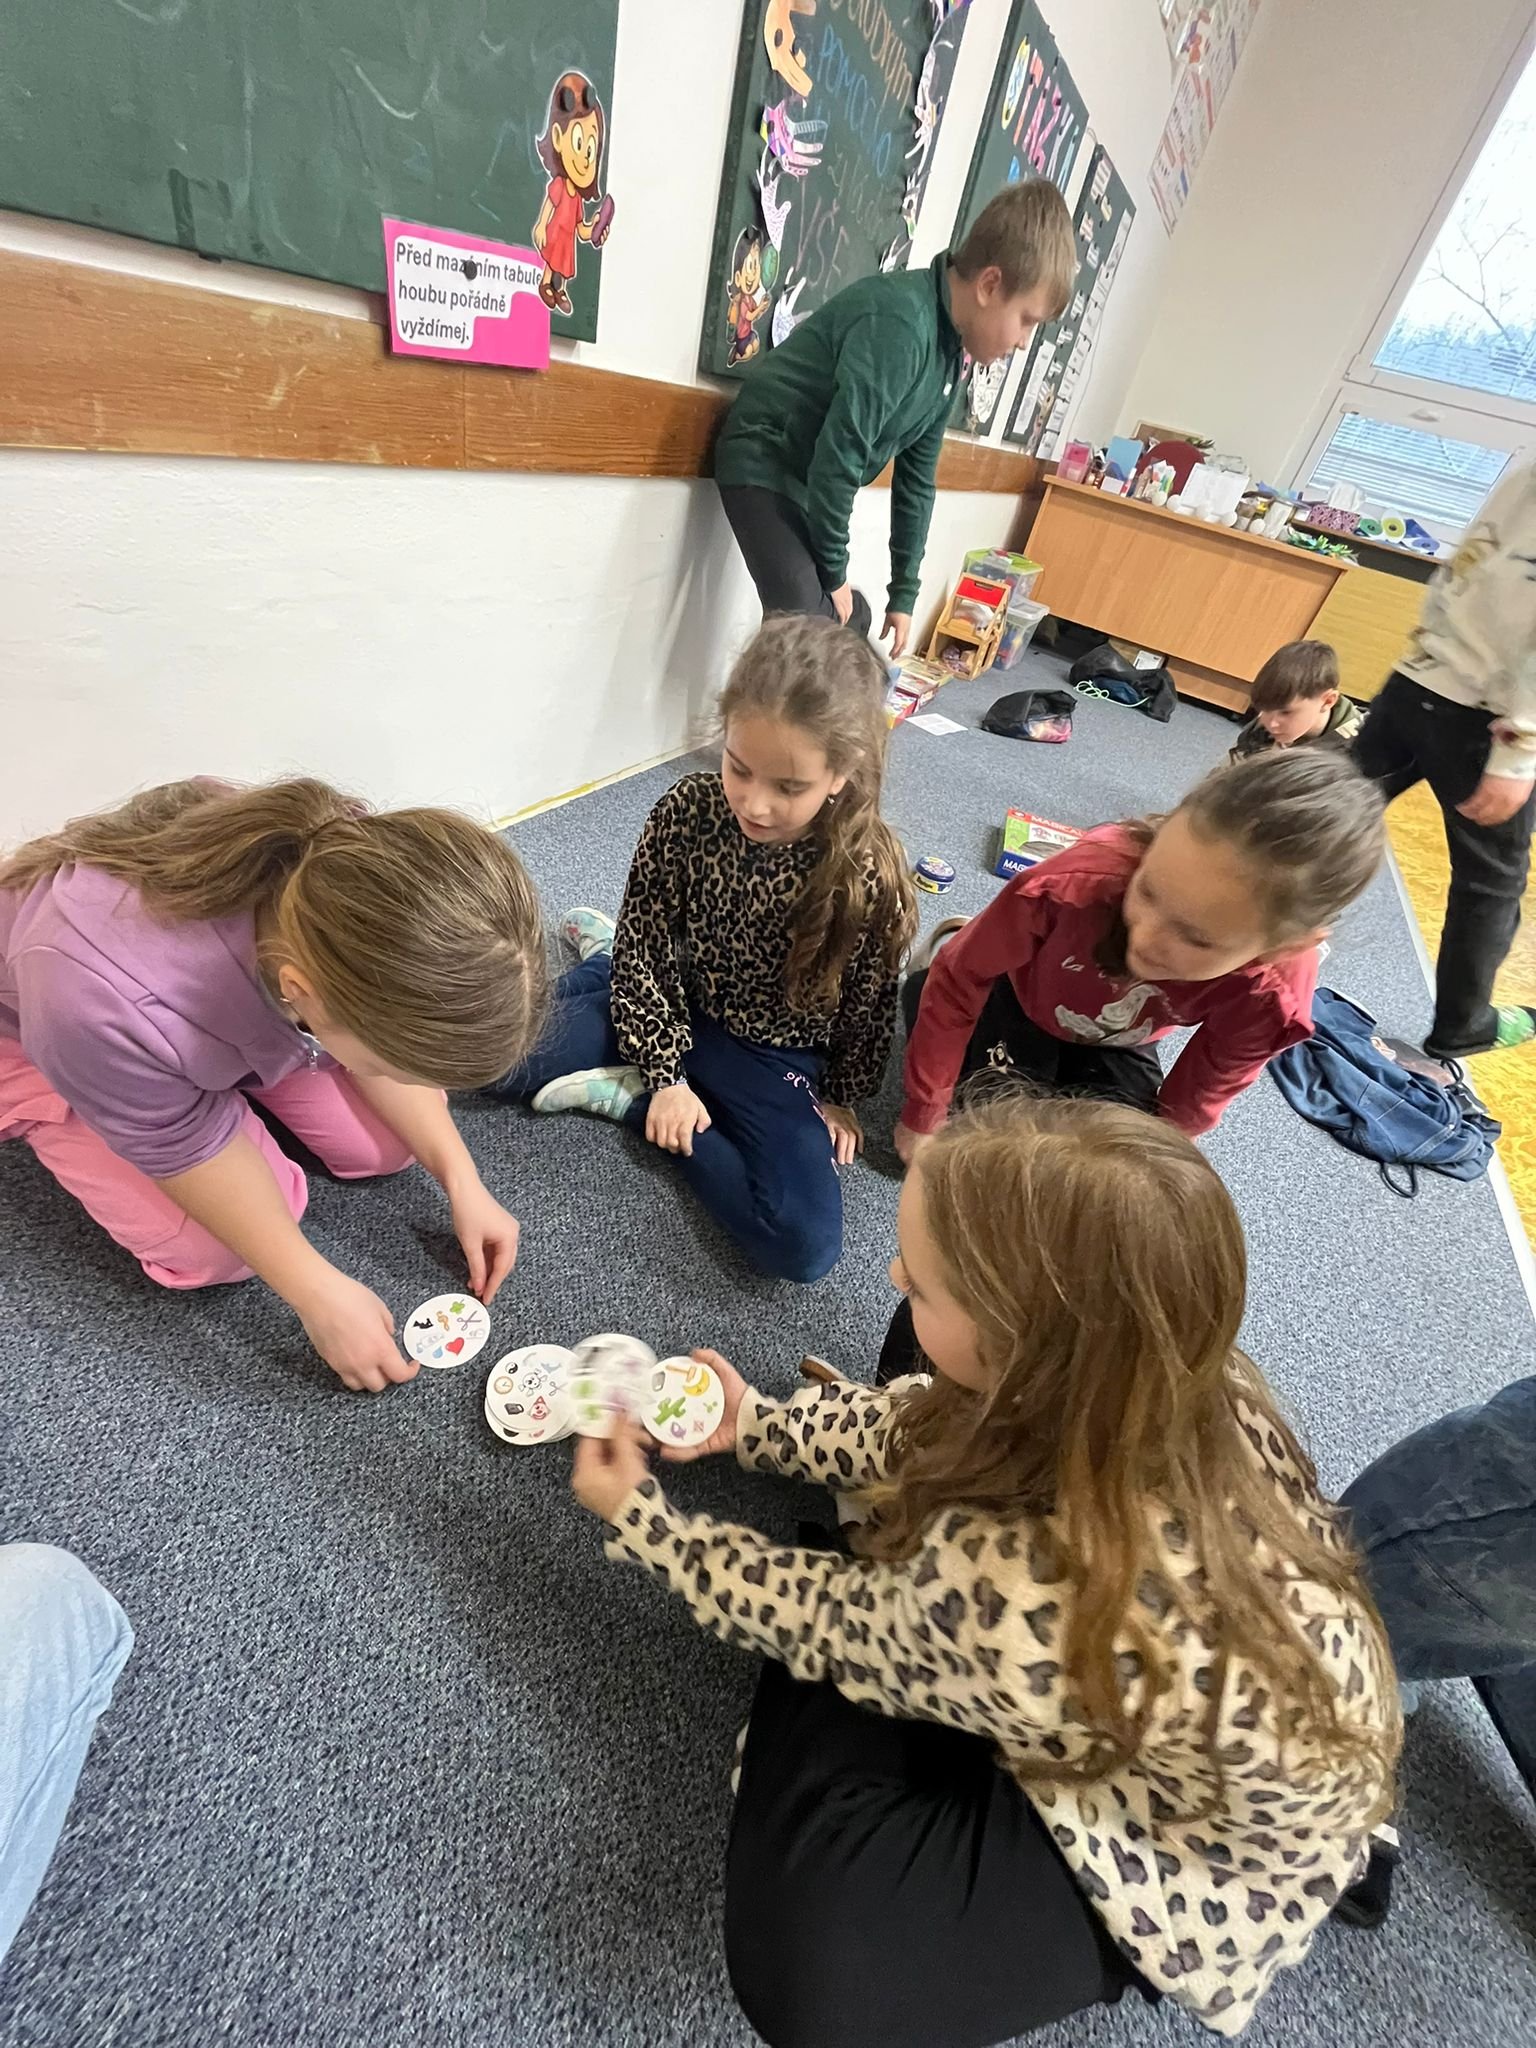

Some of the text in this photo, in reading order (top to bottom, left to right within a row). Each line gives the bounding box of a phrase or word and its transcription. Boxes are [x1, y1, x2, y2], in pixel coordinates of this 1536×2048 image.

[396, 242, 432, 267] Před
[436, 254, 501, 280] mazním
[398, 280, 506, 313] houbu pořádně
[400, 317, 471, 344] vyždímej.
[1002, 858, 1026, 873] MAG
